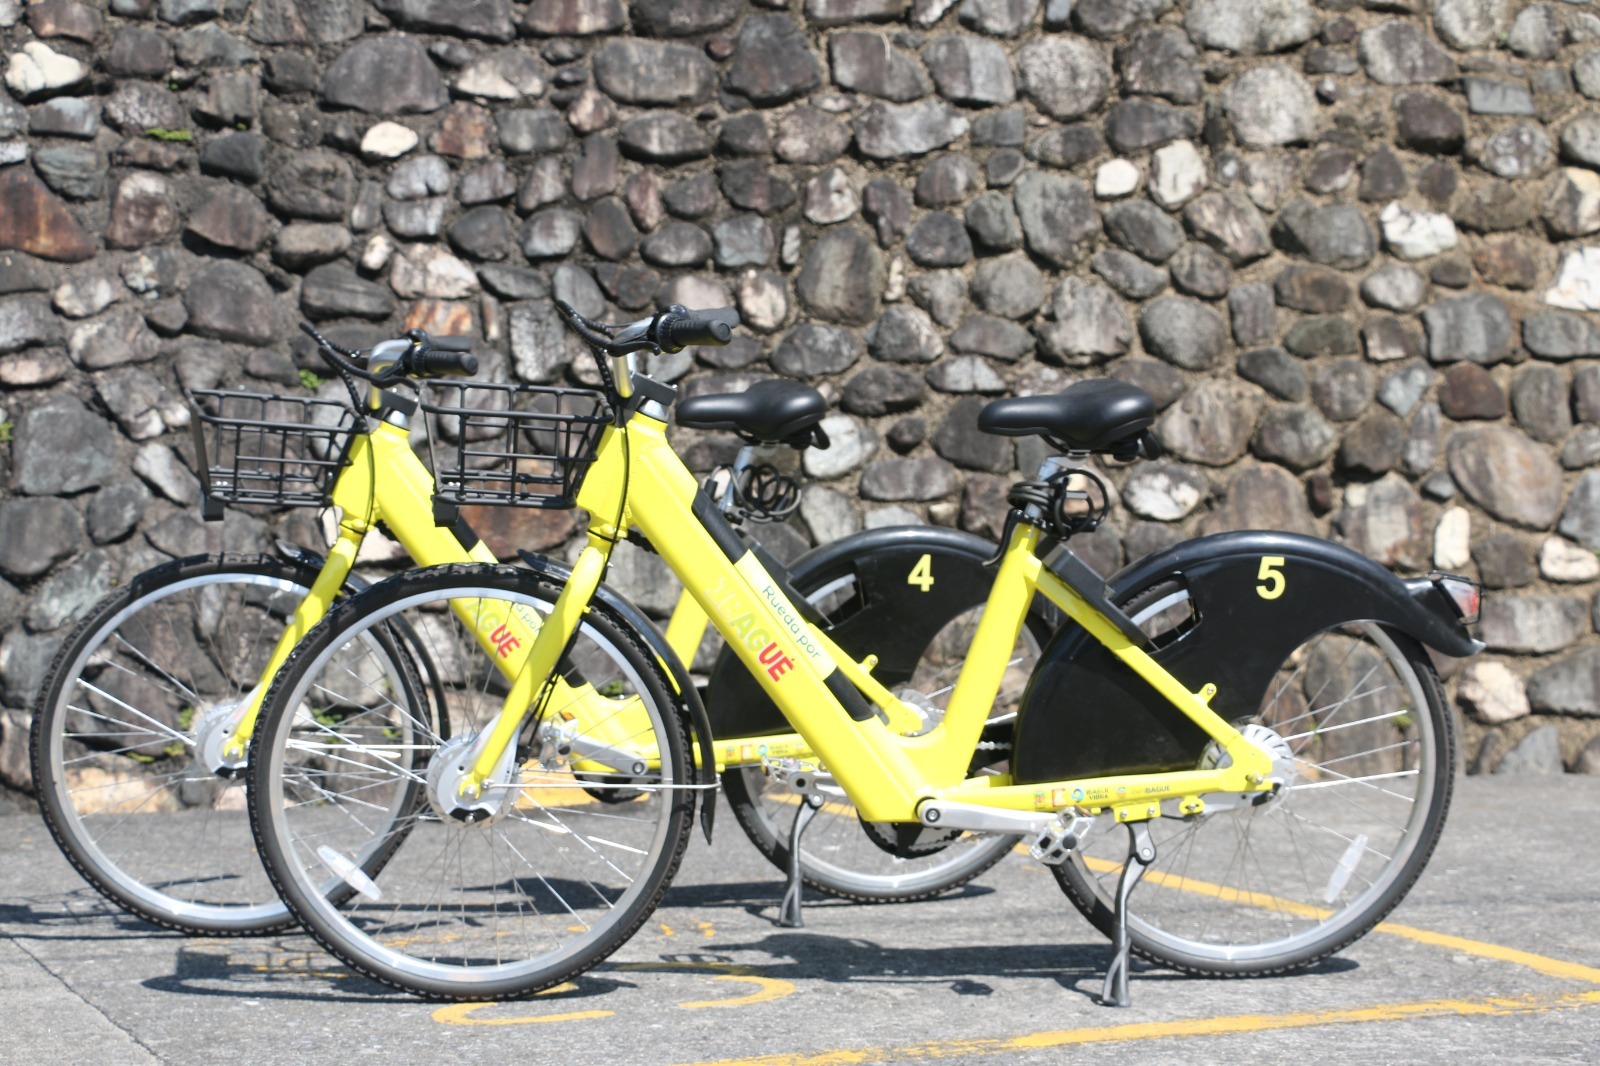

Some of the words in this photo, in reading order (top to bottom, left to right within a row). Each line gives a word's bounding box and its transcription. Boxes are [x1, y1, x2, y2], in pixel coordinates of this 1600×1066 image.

[907, 553, 935, 592] 4
[1255, 556, 1287, 600] 5
[762, 585, 801, 634] Rueda
[796, 634, 821, 658] por
